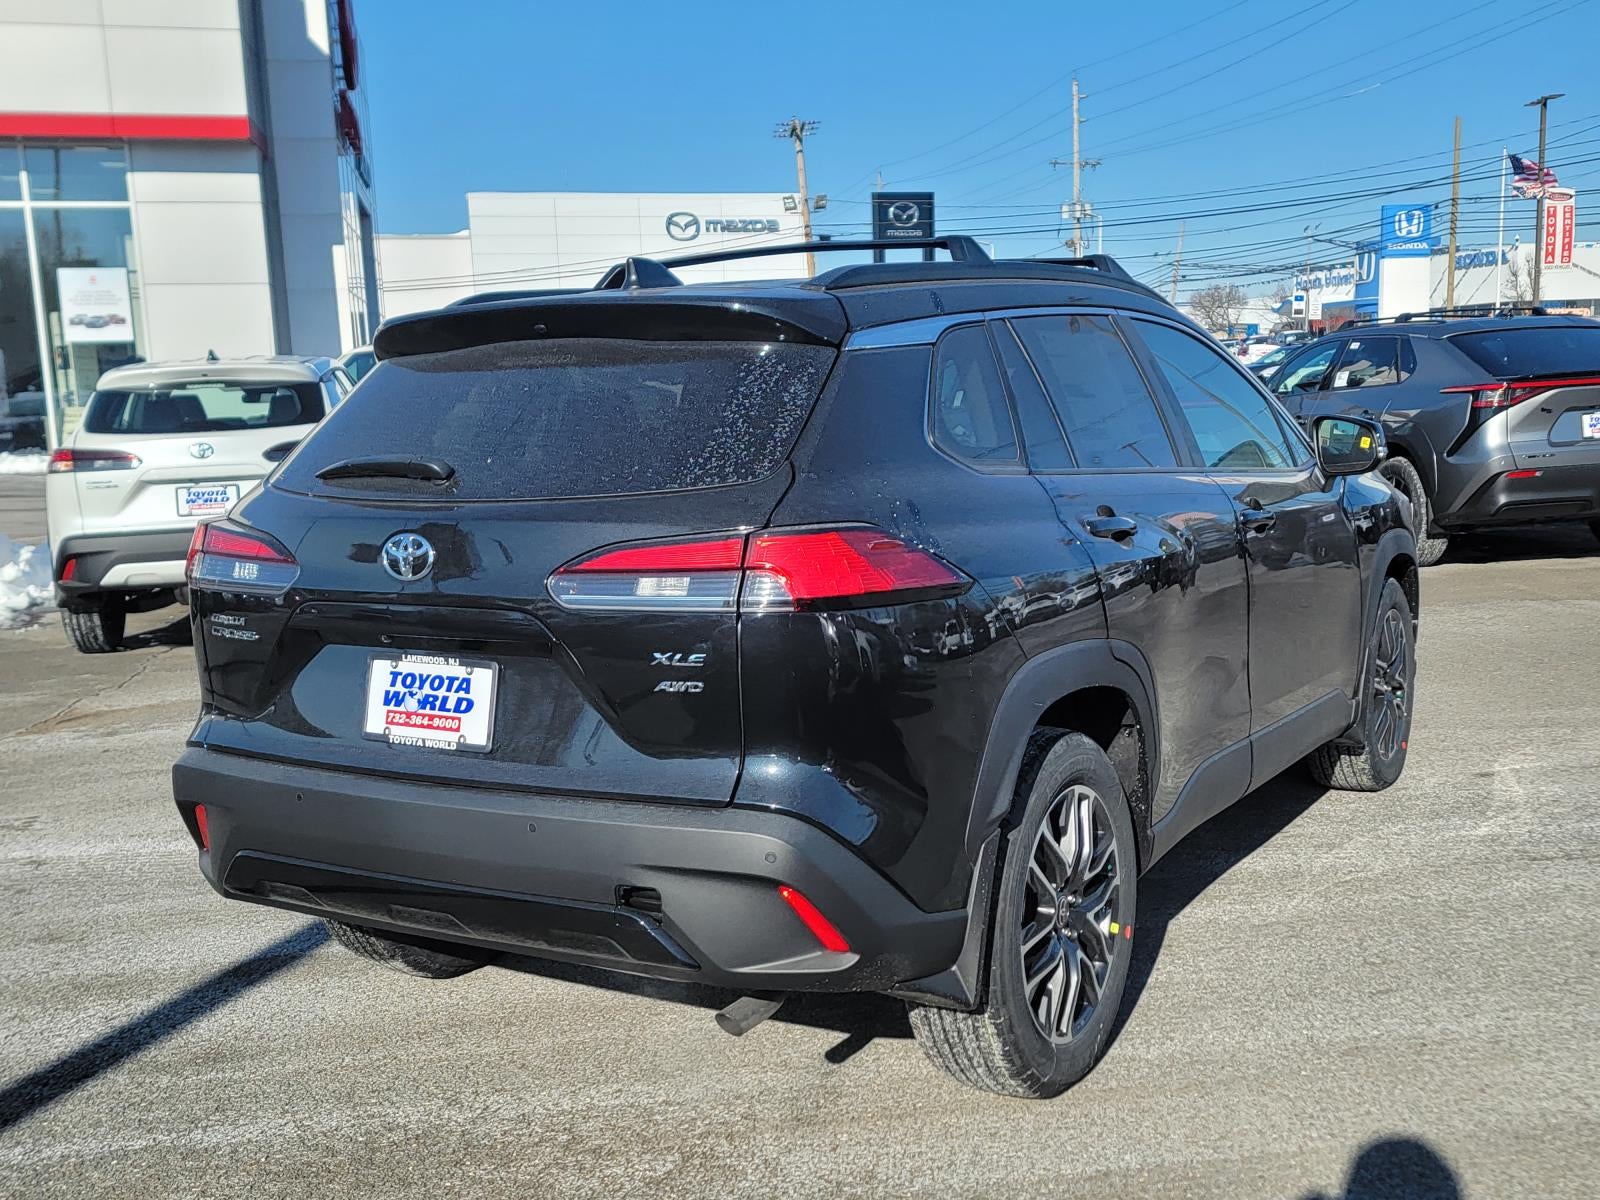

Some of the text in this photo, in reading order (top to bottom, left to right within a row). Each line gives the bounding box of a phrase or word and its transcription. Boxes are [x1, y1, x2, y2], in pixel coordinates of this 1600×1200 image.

[1545, 207, 1556, 263] TOYOTA
[1562, 206, 1572, 263] CERTIFIED
[1386, 242, 1429, 250] HONDA
[187, 489, 228, 498] TOYOTA
[448, 657, 460, 666] NJ
[650, 652, 707, 666] XLE
[389, 671, 472, 695] TOYOTA
[654, 681, 705, 693] AWD
[383, 689, 475, 714] WORLD
[387, 713, 459, 729] 732-364-9000
[389, 735, 457, 750] TOYOTA WORLD
